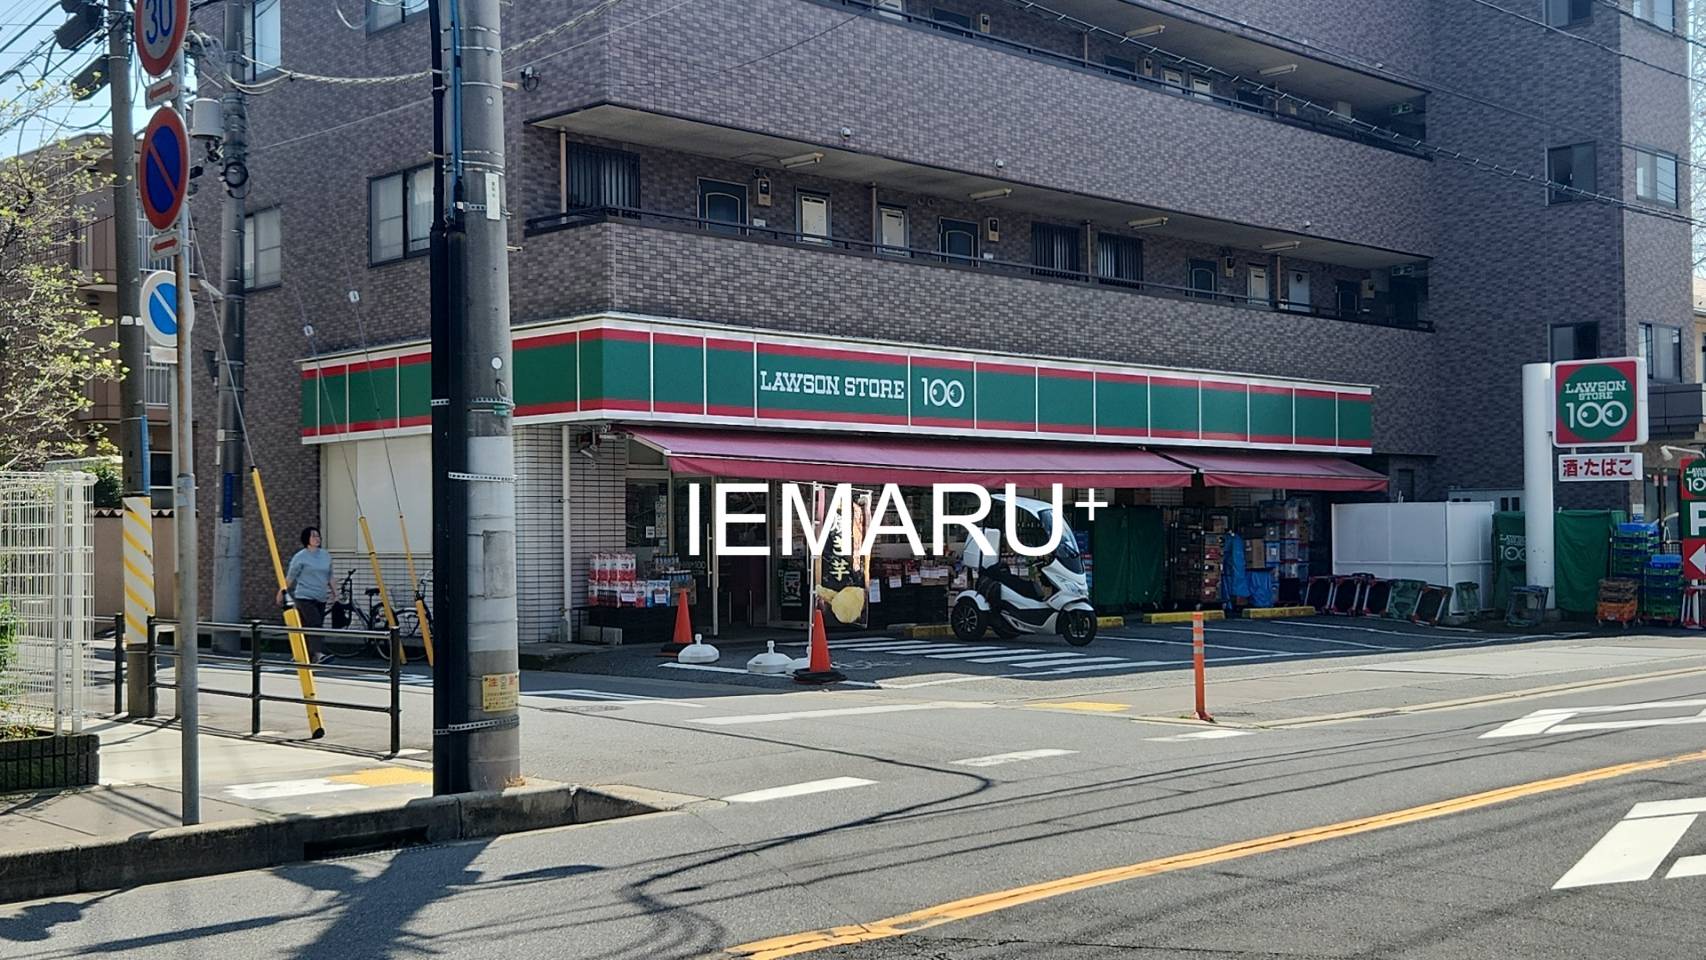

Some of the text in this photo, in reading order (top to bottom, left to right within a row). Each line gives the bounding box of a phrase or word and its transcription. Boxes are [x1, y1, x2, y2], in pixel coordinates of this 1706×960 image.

[146, 0, 172, 44] 30
[760, 370, 965, 408] LAWSON STORE 100
[1565, 380, 1626, 393] LAWSON
[1578, 392, 1613, 400] STORE
[1565, 401, 1627, 428] 100
[1562, 458, 1633, 477] 酒・たばこ
[1686, 477, 1706, 492] 10
